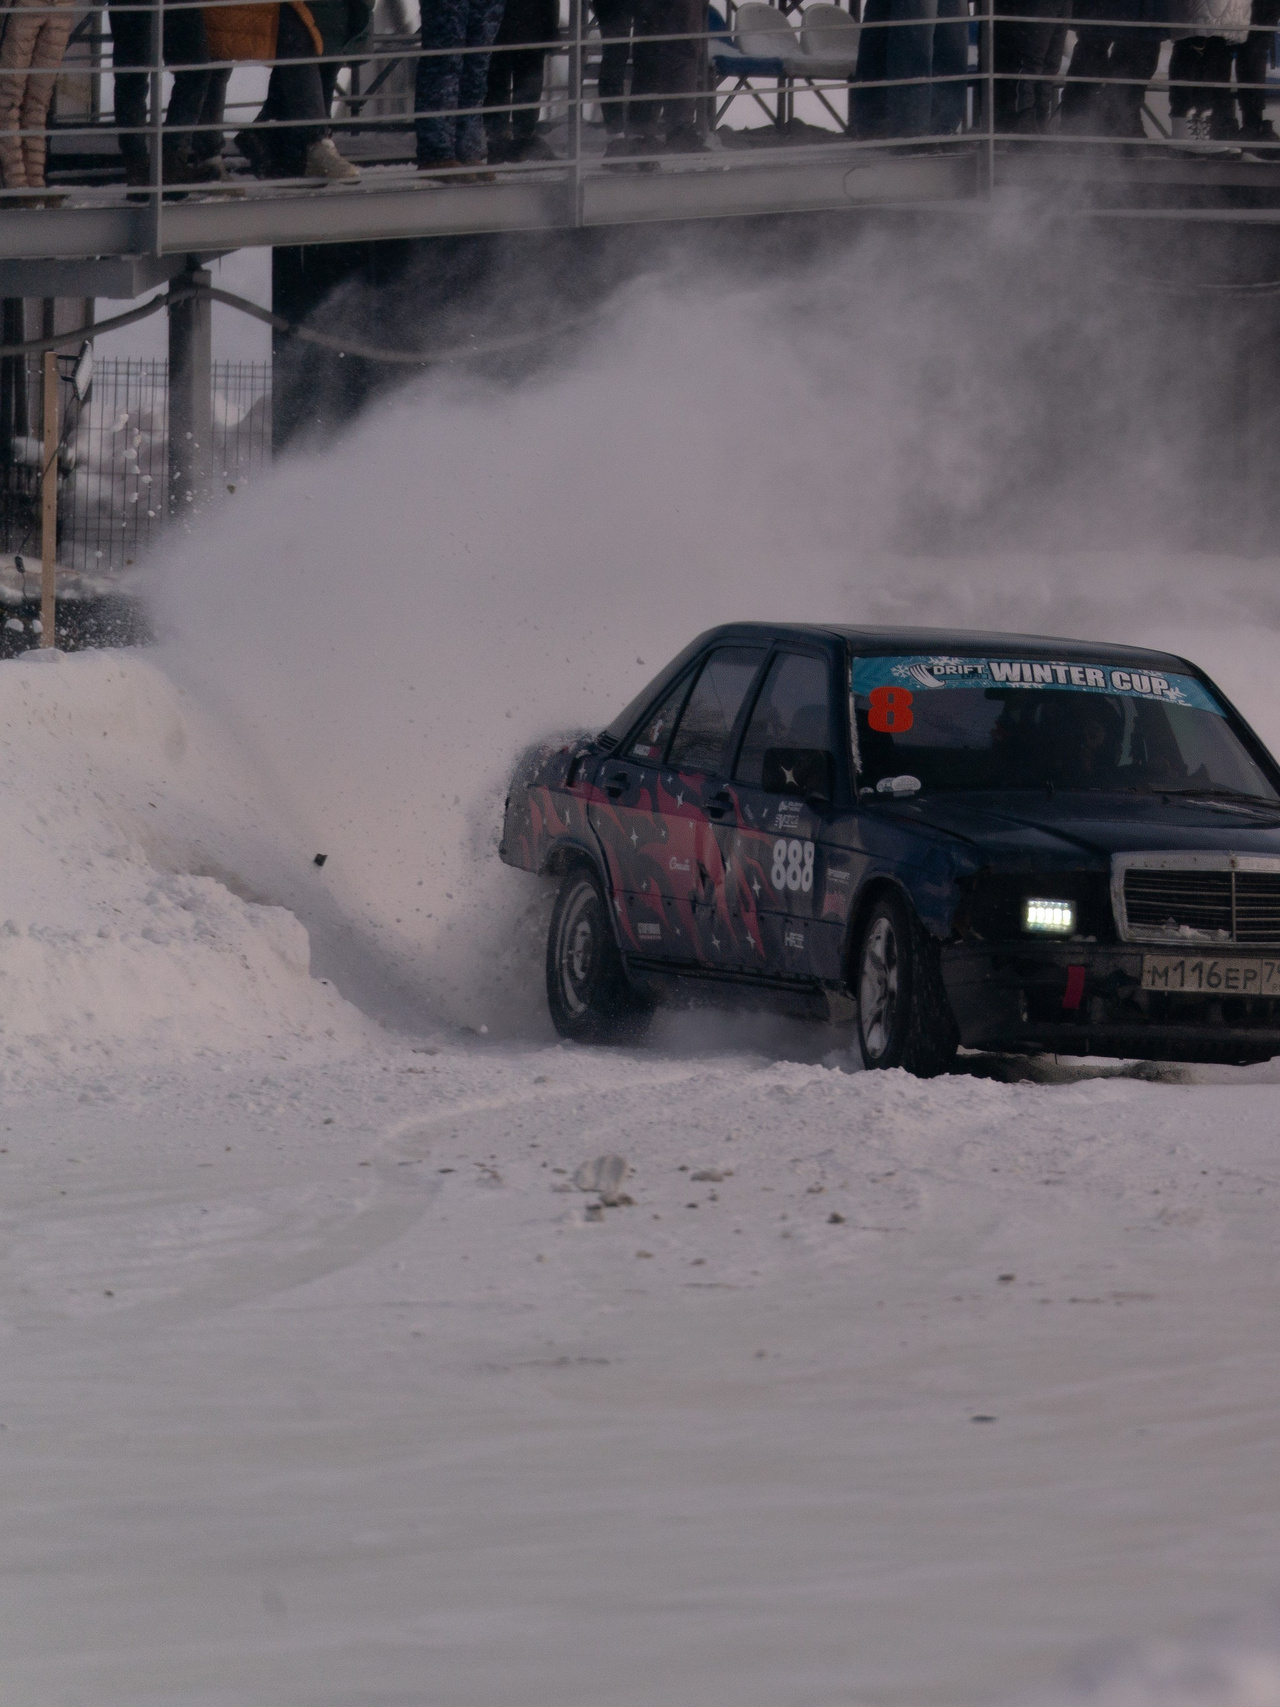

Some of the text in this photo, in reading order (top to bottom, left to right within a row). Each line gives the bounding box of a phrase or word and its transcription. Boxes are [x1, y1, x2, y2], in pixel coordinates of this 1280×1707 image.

[932, 661, 1170, 697] DRIFT WINTER CUP
[867, 686, 914, 733] 8
[771, 838, 815, 892] 888
